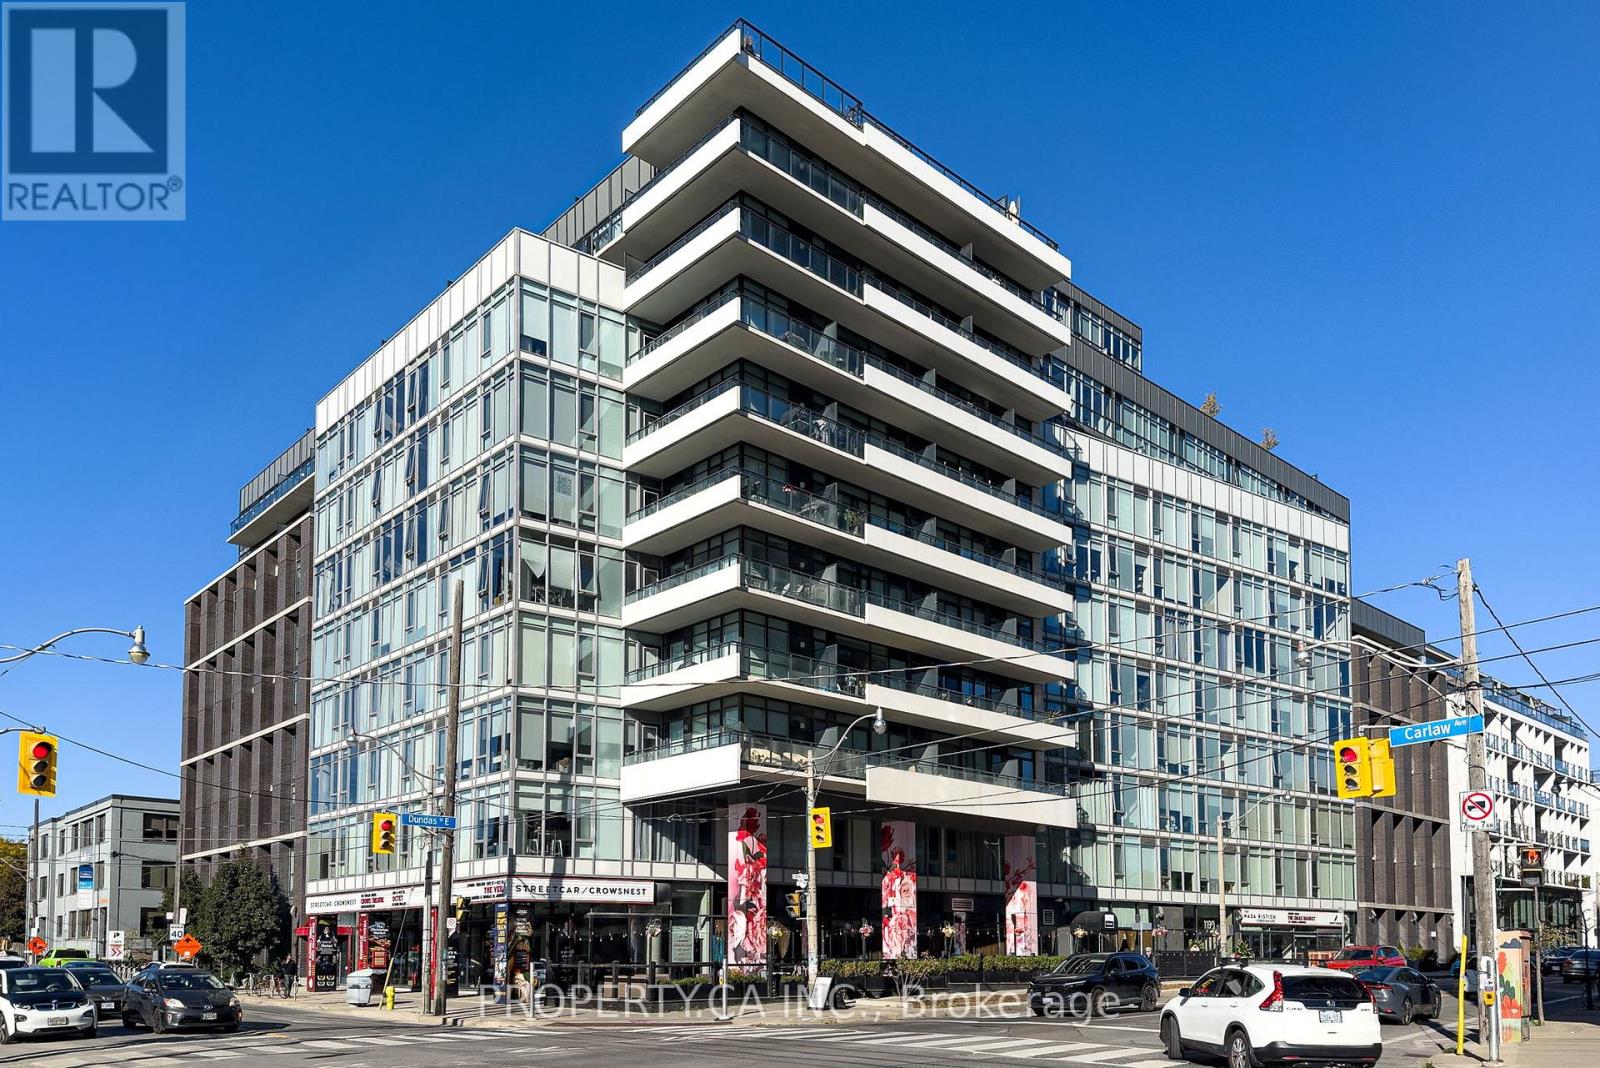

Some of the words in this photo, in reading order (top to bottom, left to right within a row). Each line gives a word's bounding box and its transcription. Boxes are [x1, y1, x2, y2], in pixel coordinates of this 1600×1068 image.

[1404, 724, 1451, 740] Carlaw
[1454, 719, 1467, 727] Ave
[408, 815, 438, 825] Dundas
[444, 818, 450, 826] E
[171, 930, 184, 939] 40
